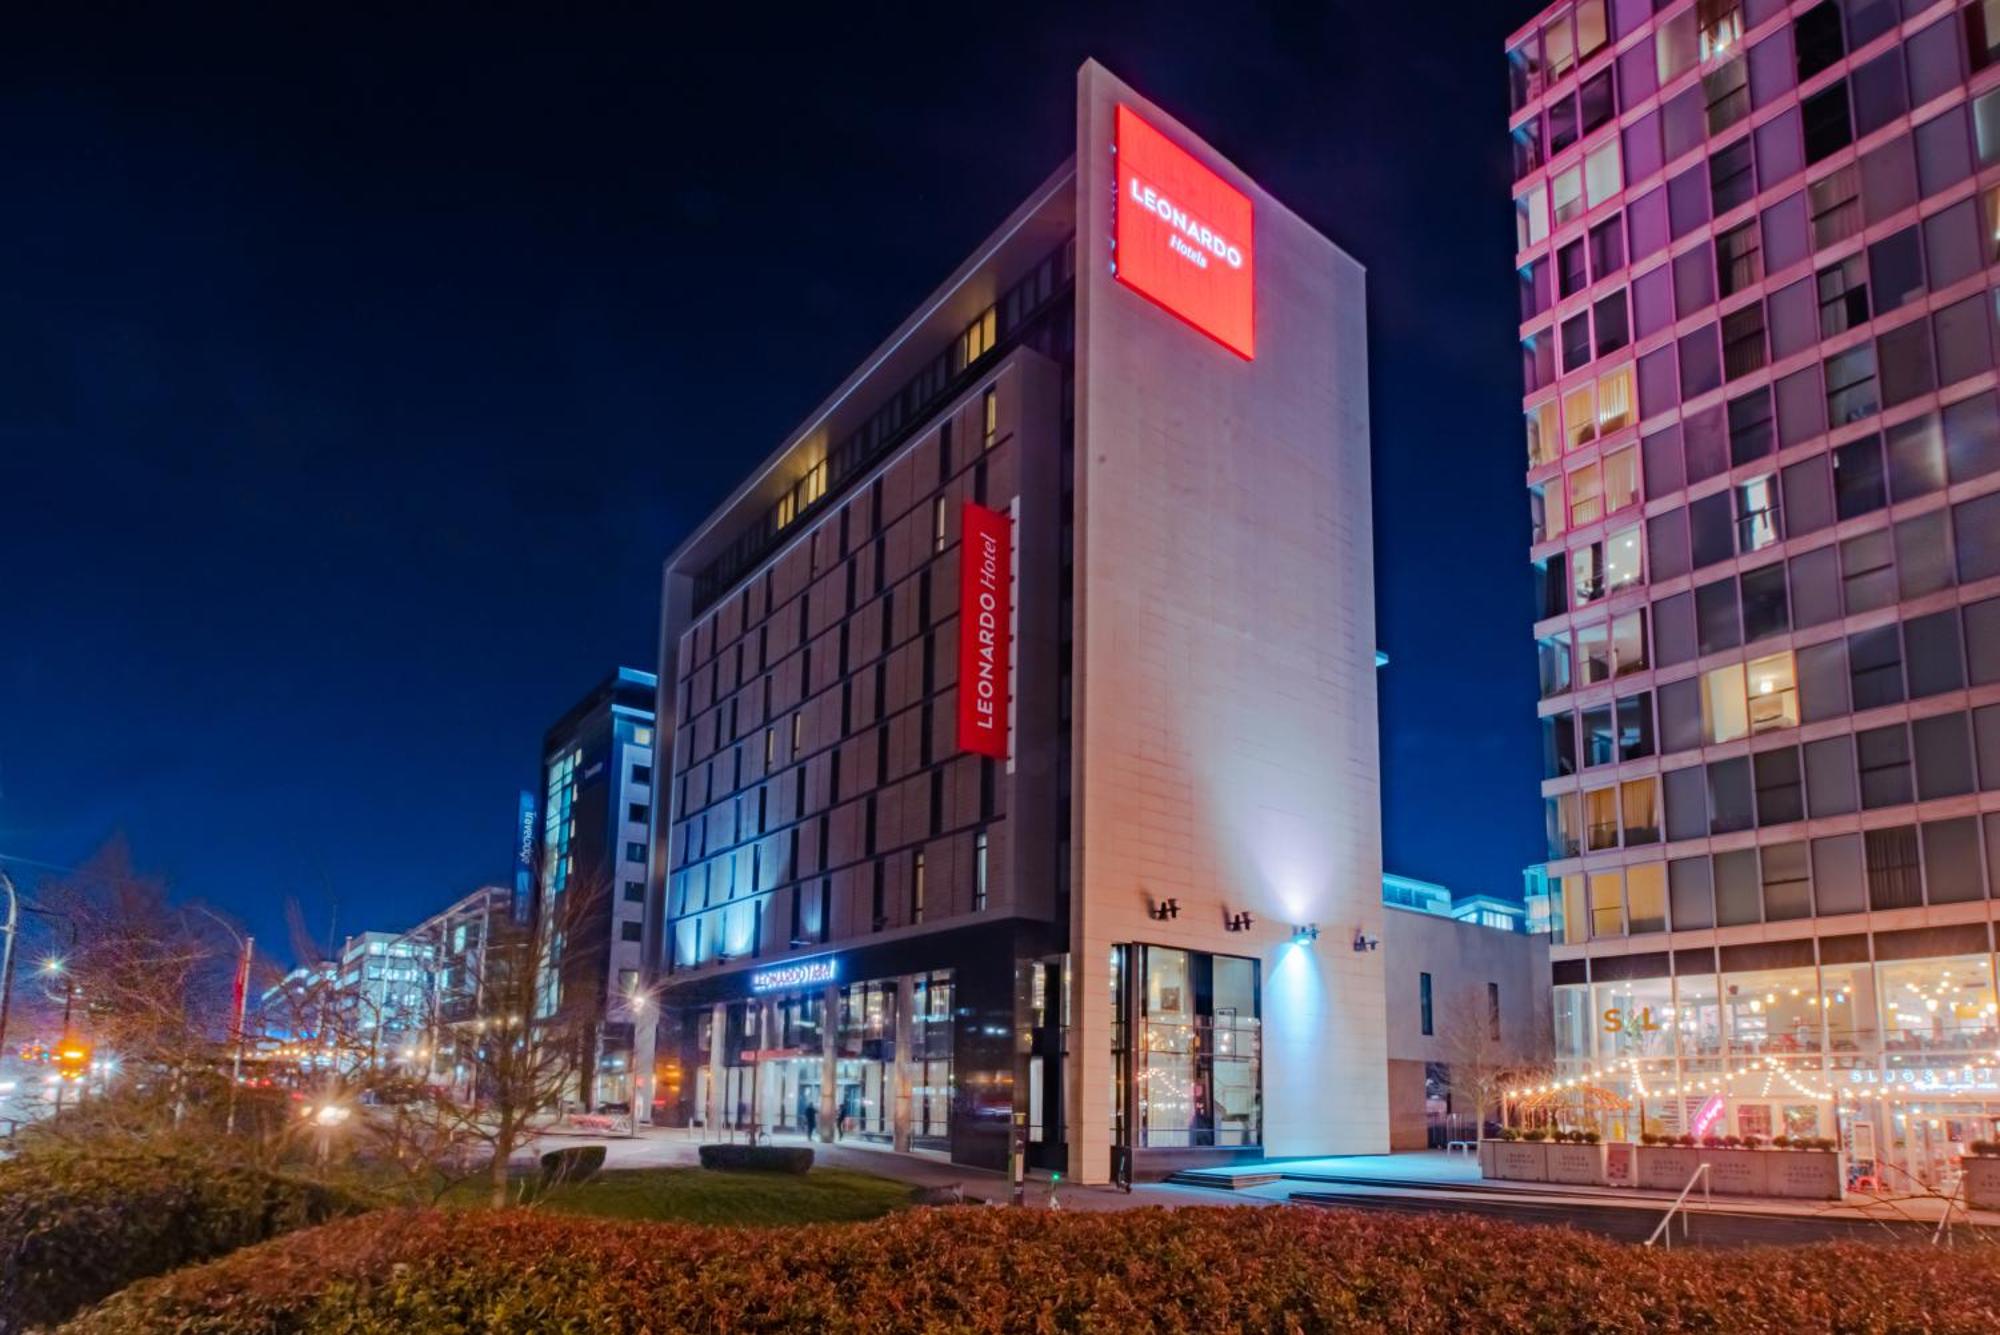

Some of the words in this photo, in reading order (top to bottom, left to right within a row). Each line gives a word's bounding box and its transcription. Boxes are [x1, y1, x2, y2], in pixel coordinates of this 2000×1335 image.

[1130, 177, 1242, 269] LEONARDO
[1169, 234, 1208, 269] Hotels
[980, 532, 998, 591] Hotel
[977, 592, 996, 729] LEONARDO
